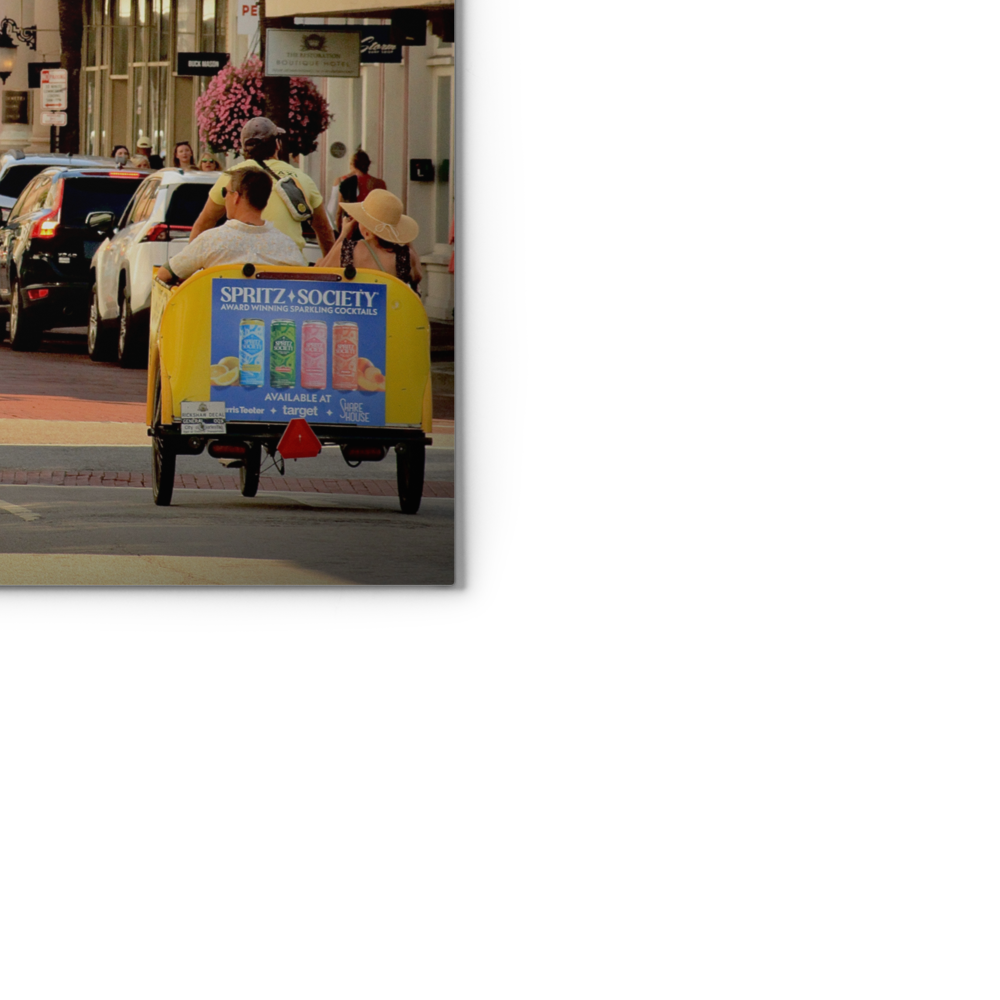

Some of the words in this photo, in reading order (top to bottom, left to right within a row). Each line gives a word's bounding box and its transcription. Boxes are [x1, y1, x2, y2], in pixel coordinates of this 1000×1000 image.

[242, 4, 258, 16] PE
[220, 286, 287, 304] SPRITZ
[297, 287, 375, 308] SOCIETY
[251, 305, 289, 313] WINNING
[290, 306, 334, 314] SPARKLING
[334, 307, 378, 316] COCKTAILS
[264, 392, 317, 403] AVAILABLE
[319, 394, 332, 404] AT
[225, 406, 239, 414] rris
[282, 404, 318, 418] target
